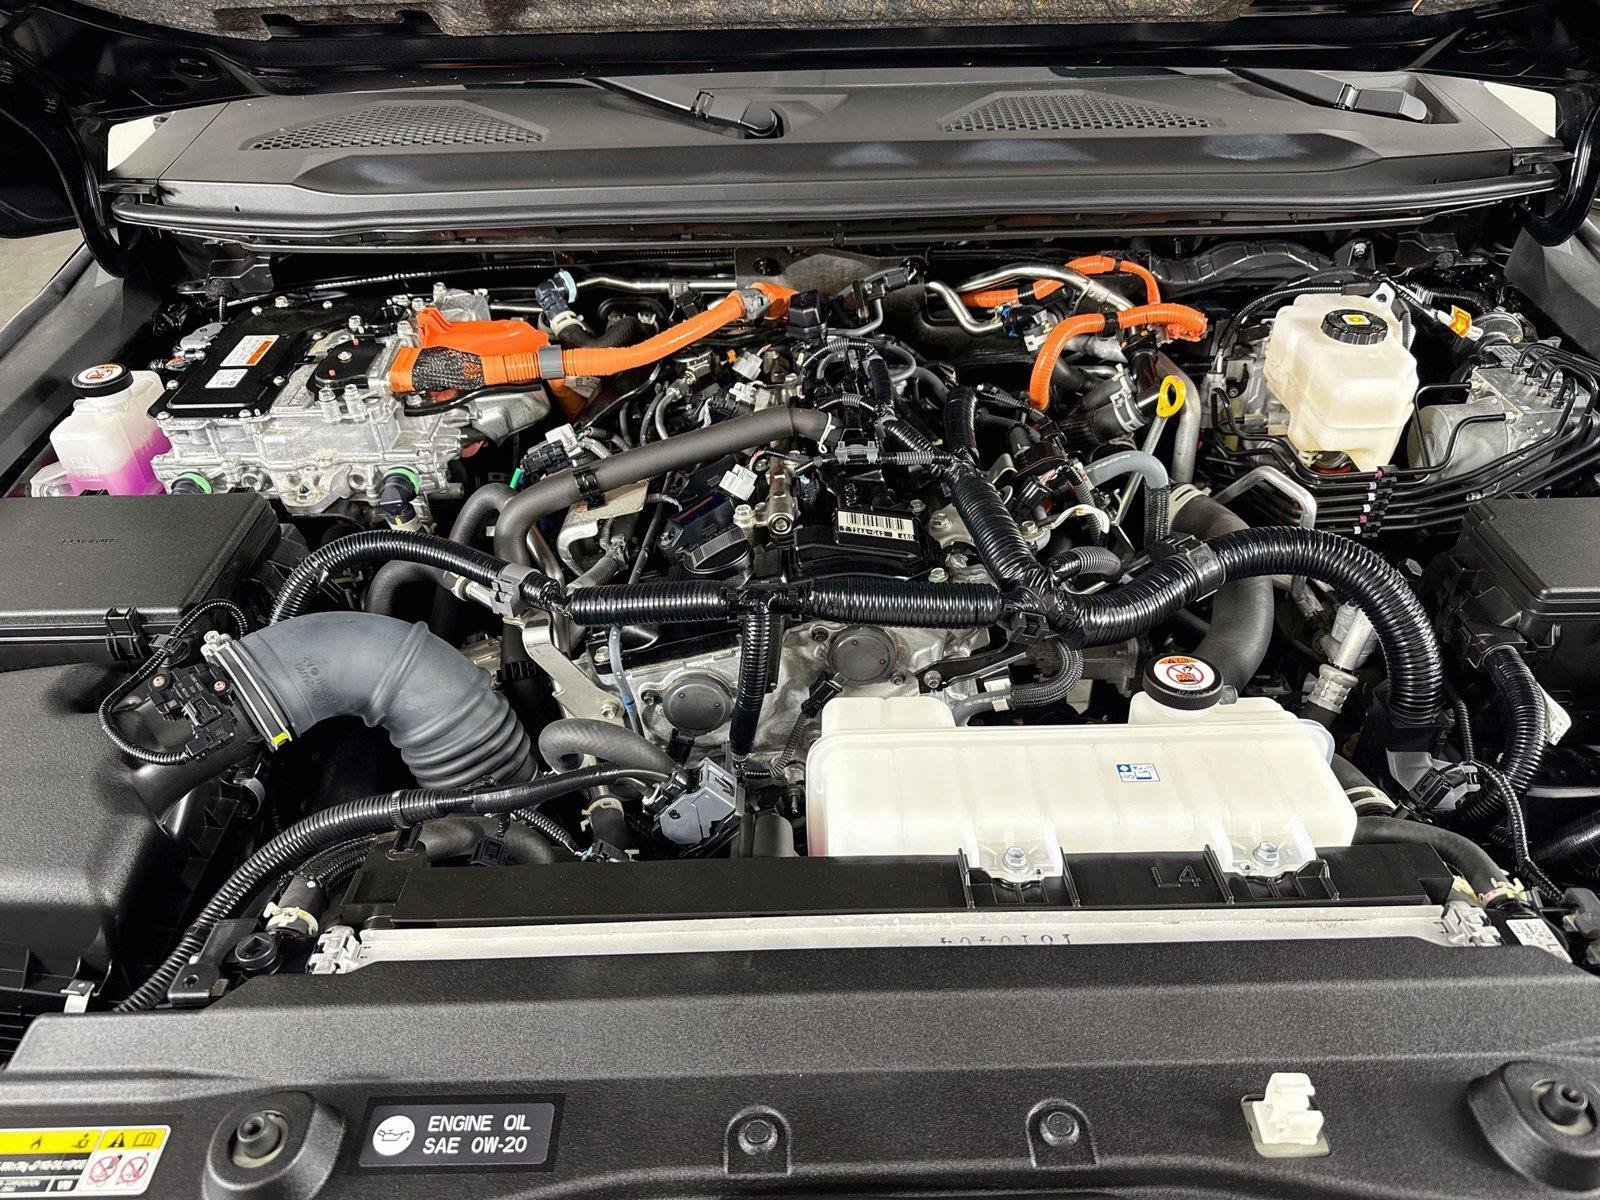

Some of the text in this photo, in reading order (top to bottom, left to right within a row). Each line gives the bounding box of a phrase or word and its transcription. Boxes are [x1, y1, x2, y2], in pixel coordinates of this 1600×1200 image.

[1151, 864, 1201, 888] L4
[427, 1114, 532, 1132] ENGINE OIL
[422, 1136, 528, 1154] SAE 0W-20
